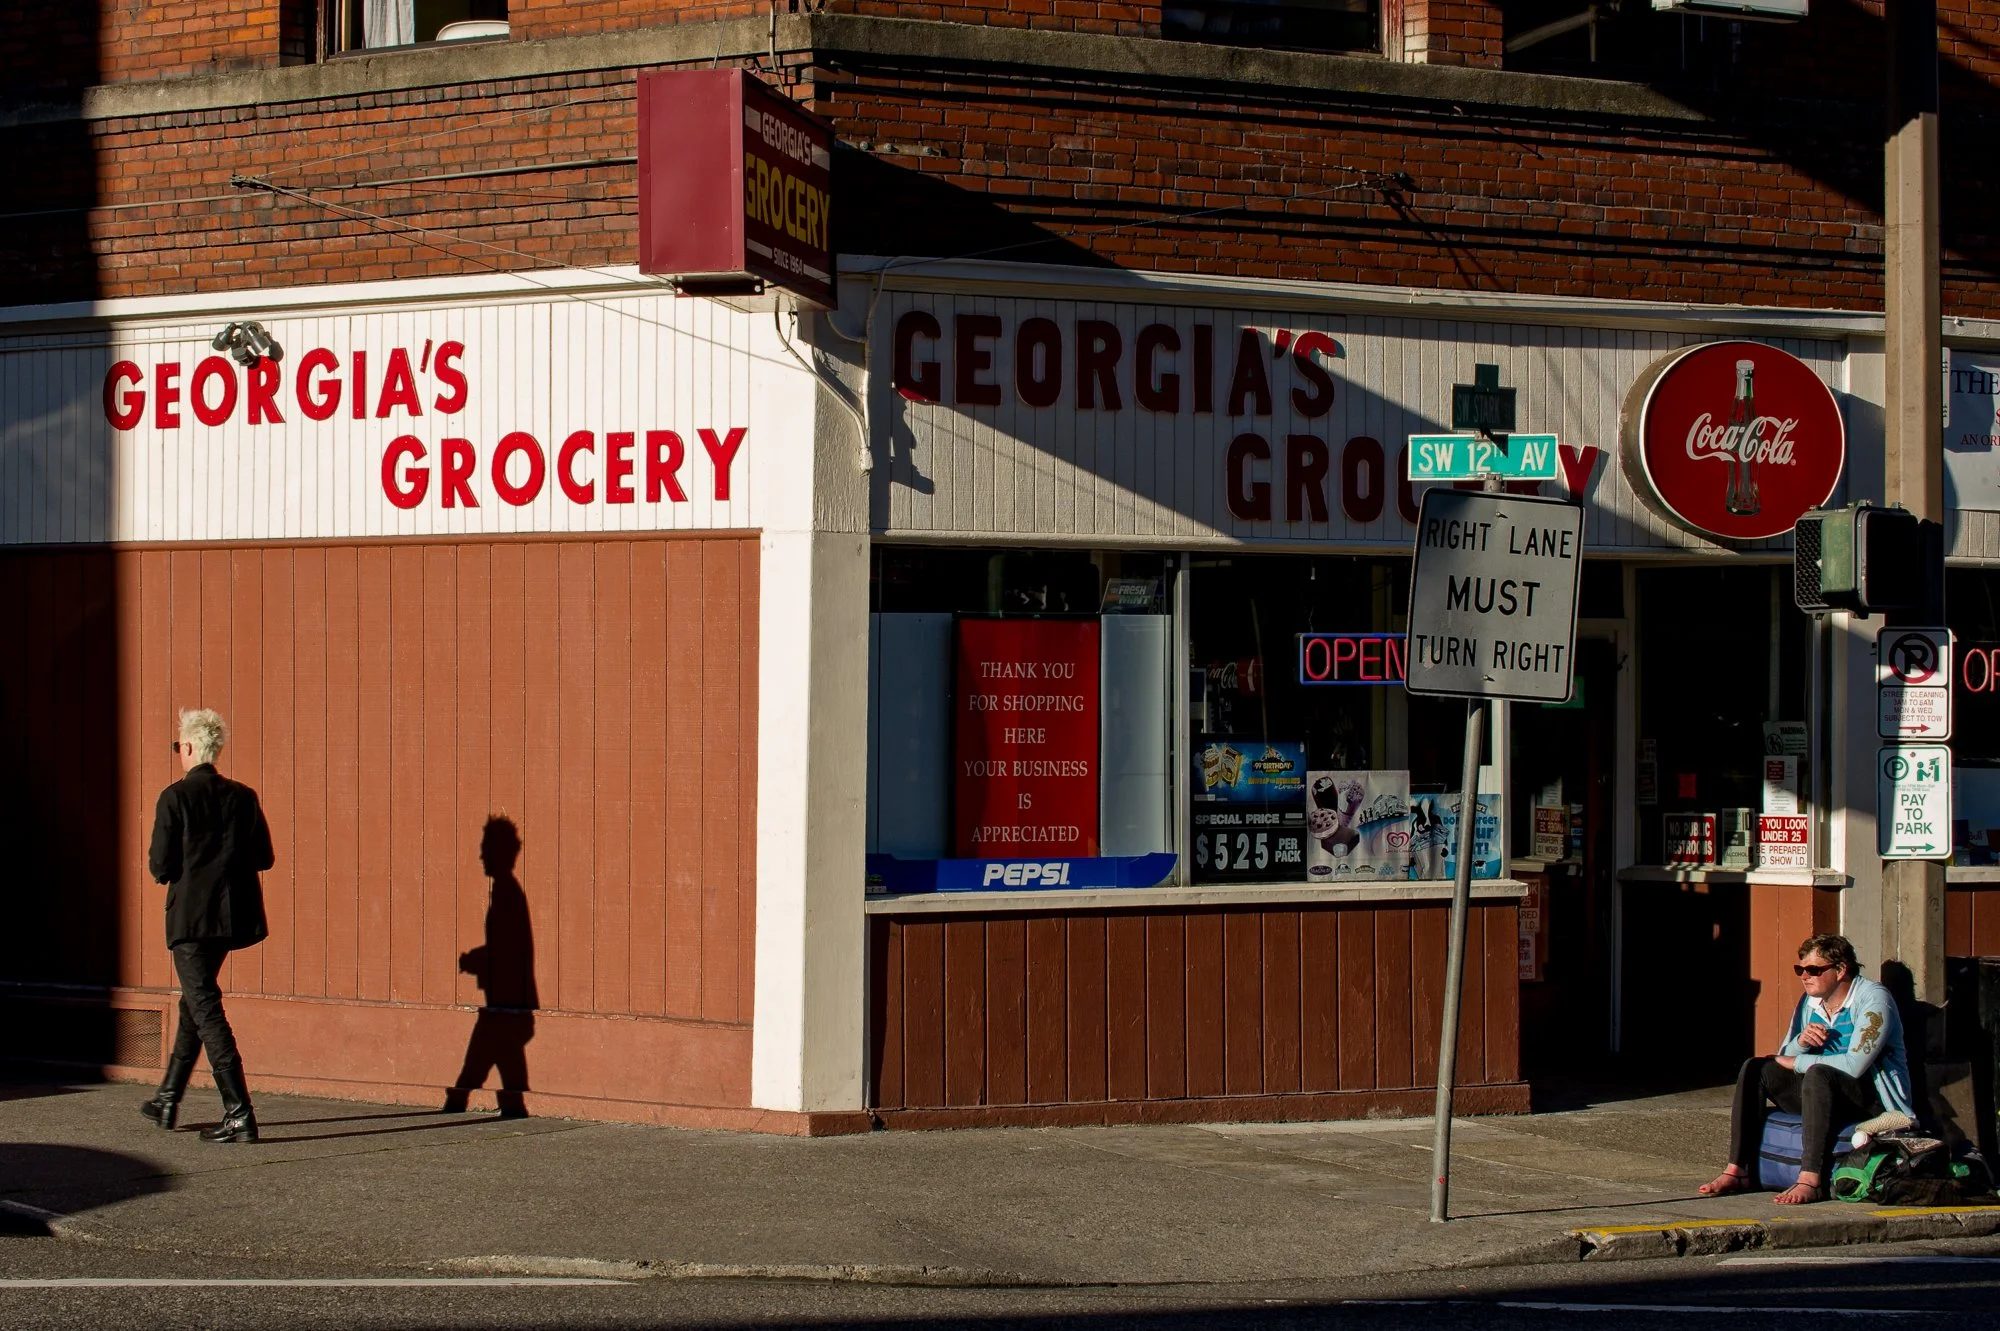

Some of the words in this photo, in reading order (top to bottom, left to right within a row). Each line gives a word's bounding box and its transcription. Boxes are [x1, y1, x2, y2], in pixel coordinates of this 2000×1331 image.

[762, 111, 811, 167] GEORGIA'S
[745, 151, 830, 253] GROCERY
[773, 247, 789, 270] SINCE
[893, 310, 1336, 418] GEORGIA'S
[103, 338, 468, 432] GEORGIA'S
[1456, 392, 1470, 423] SW
[1473, 393, 1501, 424] STARK
[1685, 412, 1799, 466] Coca-Cola
[1960, 434, 1978, 446] AN
[1418, 443, 1454, 473] SW
[1520, 442, 1549, 472] AV
[380, 427, 748, 510] GROCERY
[1425, 517, 1491, 552] RIGHT
[1509, 525, 1573, 559] LANE
[1118, 584, 1147, 595] FRESH
[1447, 575, 1540, 617] MUST
[1305, 637, 1408, 681] OPEN
[1416, 634, 1477, 667] TURN
[1492, 639, 1565, 673] RIGHT
[980, 661, 1038, 679] THANK
[1041, 662, 1076, 679] YOU
[968, 694, 998, 711] FOR
[1002, 694, 1084, 712] SHOPPING
[1882, 690, 1908, 698] STREET
[1910, 690, 1944, 699] CLEANING
[1909, 698, 1918, 706] TO
[1883, 714, 1914, 722] SUBJECT
[1916, 714, 1926, 722] TO
[1927, 714, 1943, 722] TOW
[1893, 706, 1909, 714] MON
[1911, 706, 1916, 714] &
[1917, 706, 1933, 714] WED
[1003, 727, 1046, 744] HERE
[964, 760, 1007, 777] YOUR
[1012, 760, 1088, 777] BUSINESS
[1017, 792, 1032, 810] IS
[1901, 794, 1927, 806] PAY
[1194, 813, 1243, 825] SPECIAL
[1245, 813, 1280, 825] PRICE
[1904, 808, 1923, 820] TO
[1669, 821, 1680, 836] NO
[1683, 821, 1711, 838] PUBLIC
[1765, 818, 1783, 830] YOU
[1784, 818, 1807, 829] LOOK
[1895, 822, 1933, 835] PARK
[971, 825, 1080, 843] APPRECIATED
[1761, 830, 1789, 842] UNDER
[1791, 830, 1802, 842] 25
[1278, 838, 1298, 850] PER
[1667, 839, 1713, 856] RESTROOMS
[1755, 844, 1766, 854] BE
[1769, 845, 1807, 855] PREPARED
[1274, 850, 1302, 863] PACK
[1756, 855, 1766, 865] TO
[1770, 855, 1792, 865] SHOW
[983, 862, 1070, 887] PEPSI
[1520, 896, 1532, 907] 25
